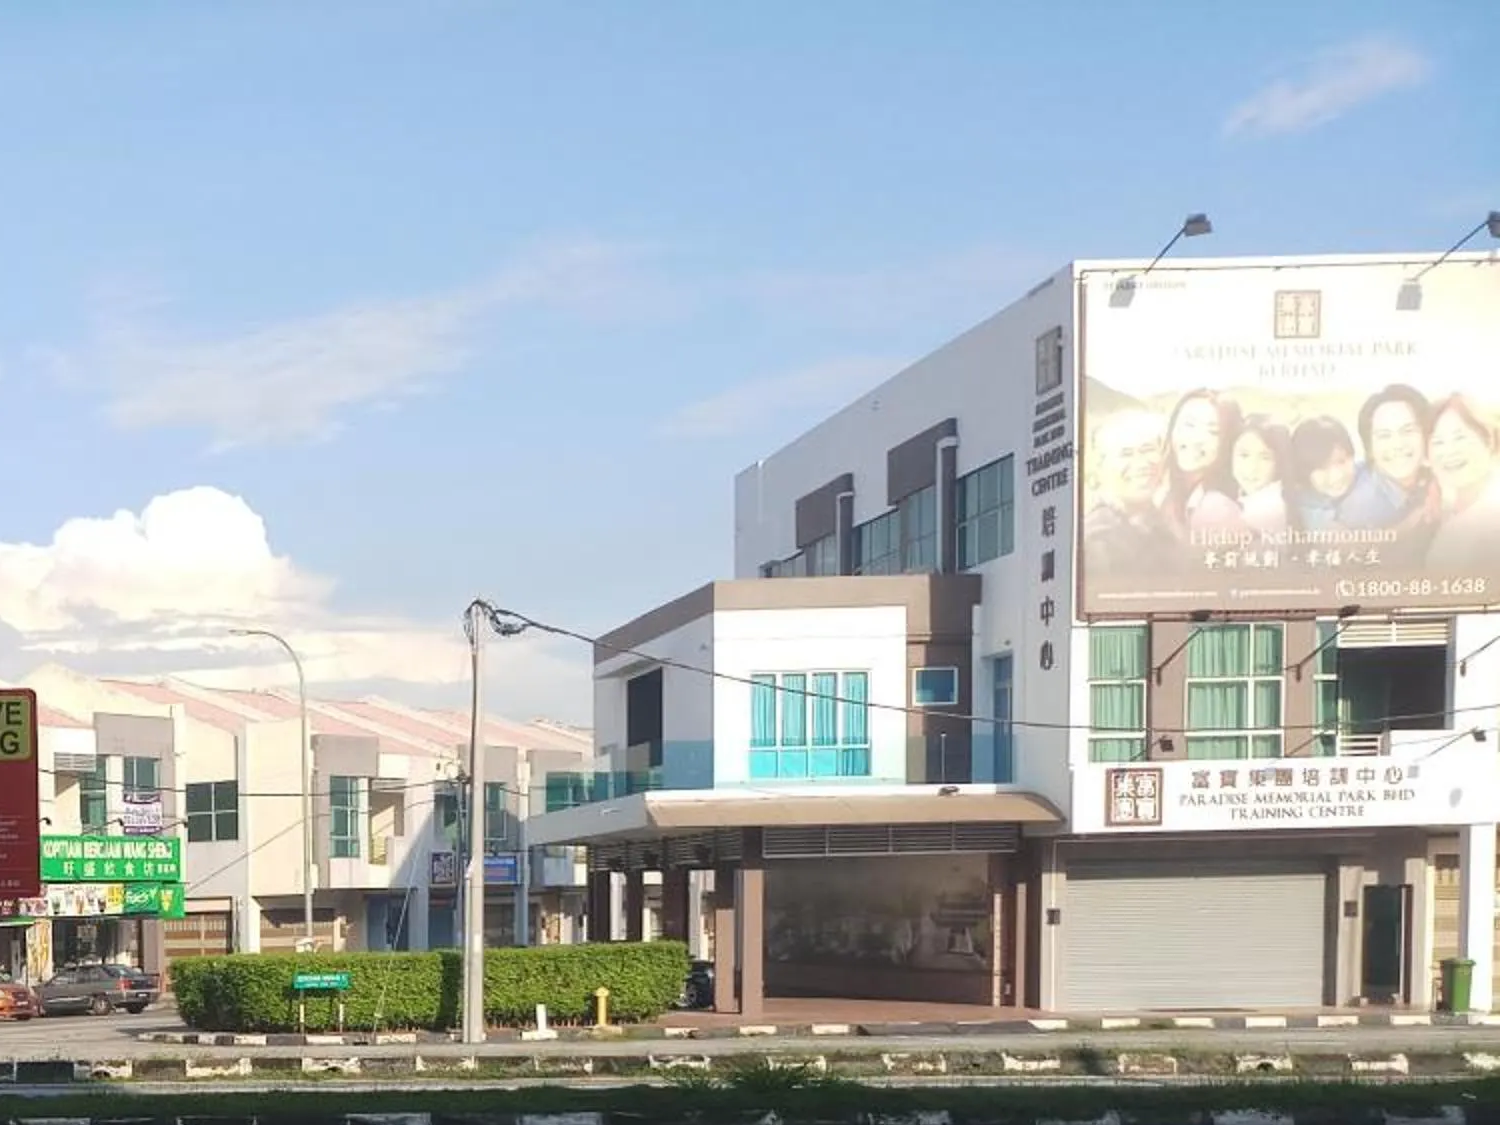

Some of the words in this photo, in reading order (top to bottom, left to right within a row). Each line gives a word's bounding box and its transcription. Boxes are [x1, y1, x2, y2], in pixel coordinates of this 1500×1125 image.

[1372, 341, 1419, 357] PARK
[1190, 527, 1252, 550] Hidup
[1179, 792, 1249, 807] PARADISE
[1253, 791, 1332, 805] MEMORIAL
[1338, 790, 1377, 803] PARK
[1229, 806, 1303, 820] TRAINING
[1308, 804, 1365, 818] CENTRE
